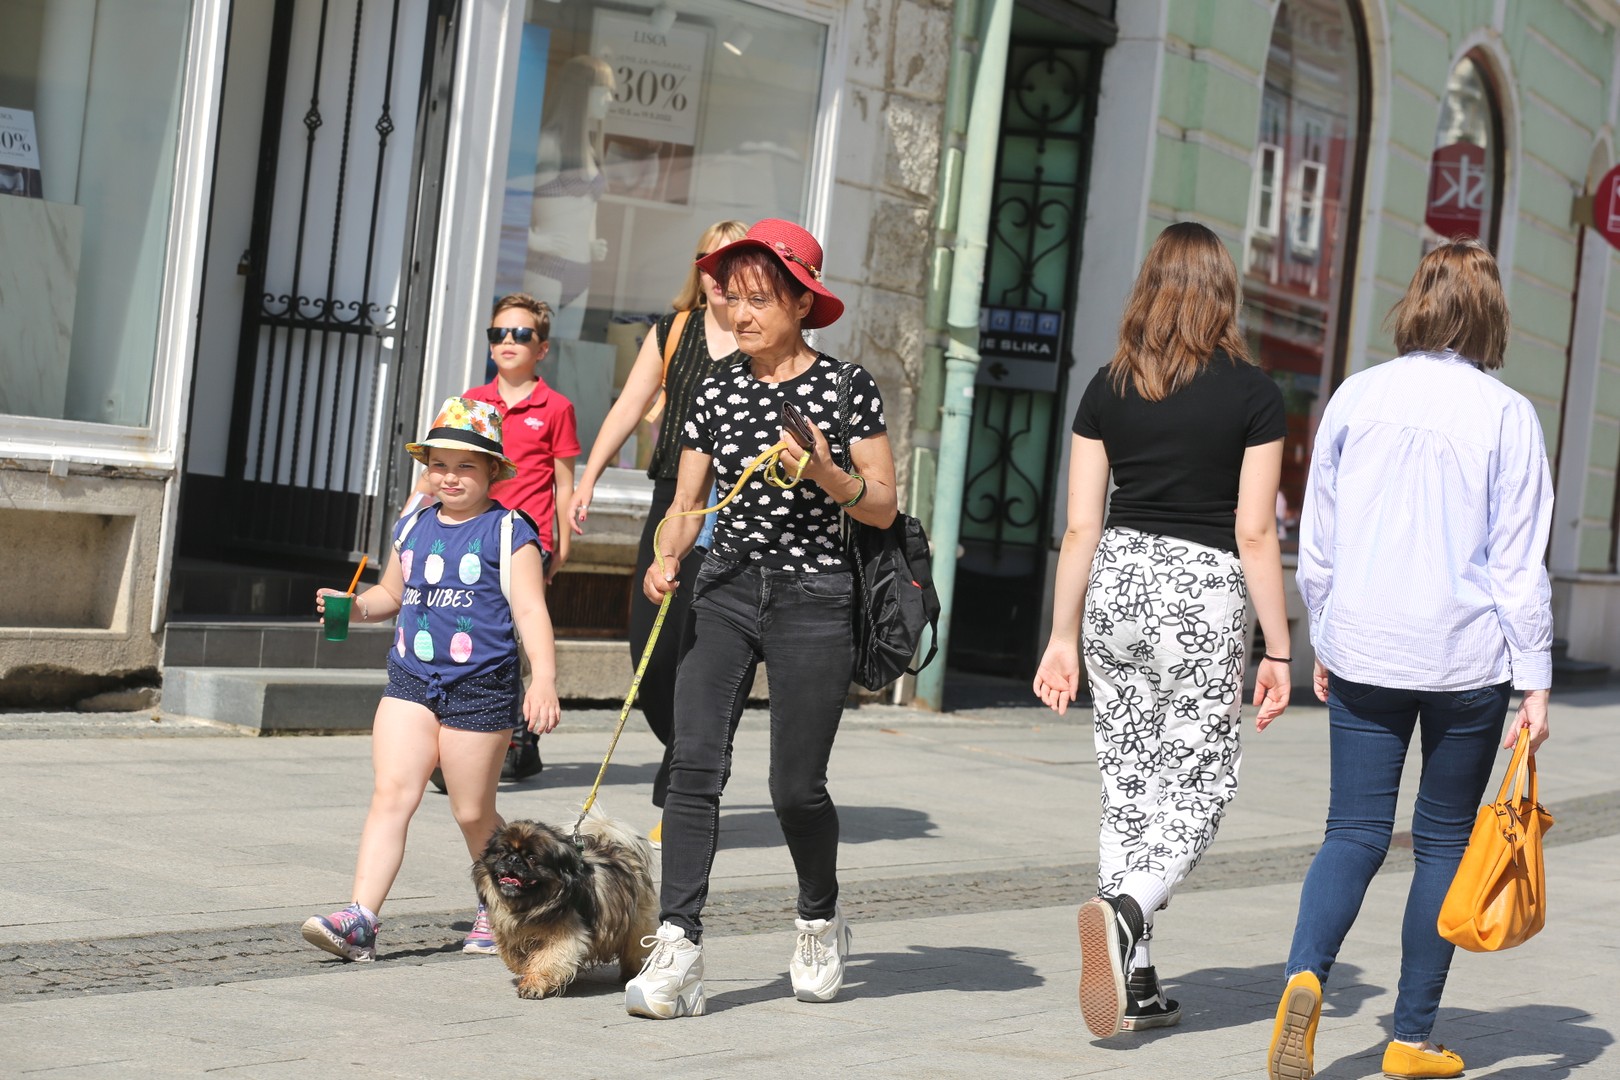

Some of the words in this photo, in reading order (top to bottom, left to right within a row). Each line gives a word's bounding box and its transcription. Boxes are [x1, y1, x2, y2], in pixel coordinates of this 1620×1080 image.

[633, 30, 667, 47] LISCA
[614, 66, 687, 112] 30%
[0, 130, 31, 153] 0%
[1000, 340, 1051, 355] SLIKA
[426, 588, 475, 608] VIBES
